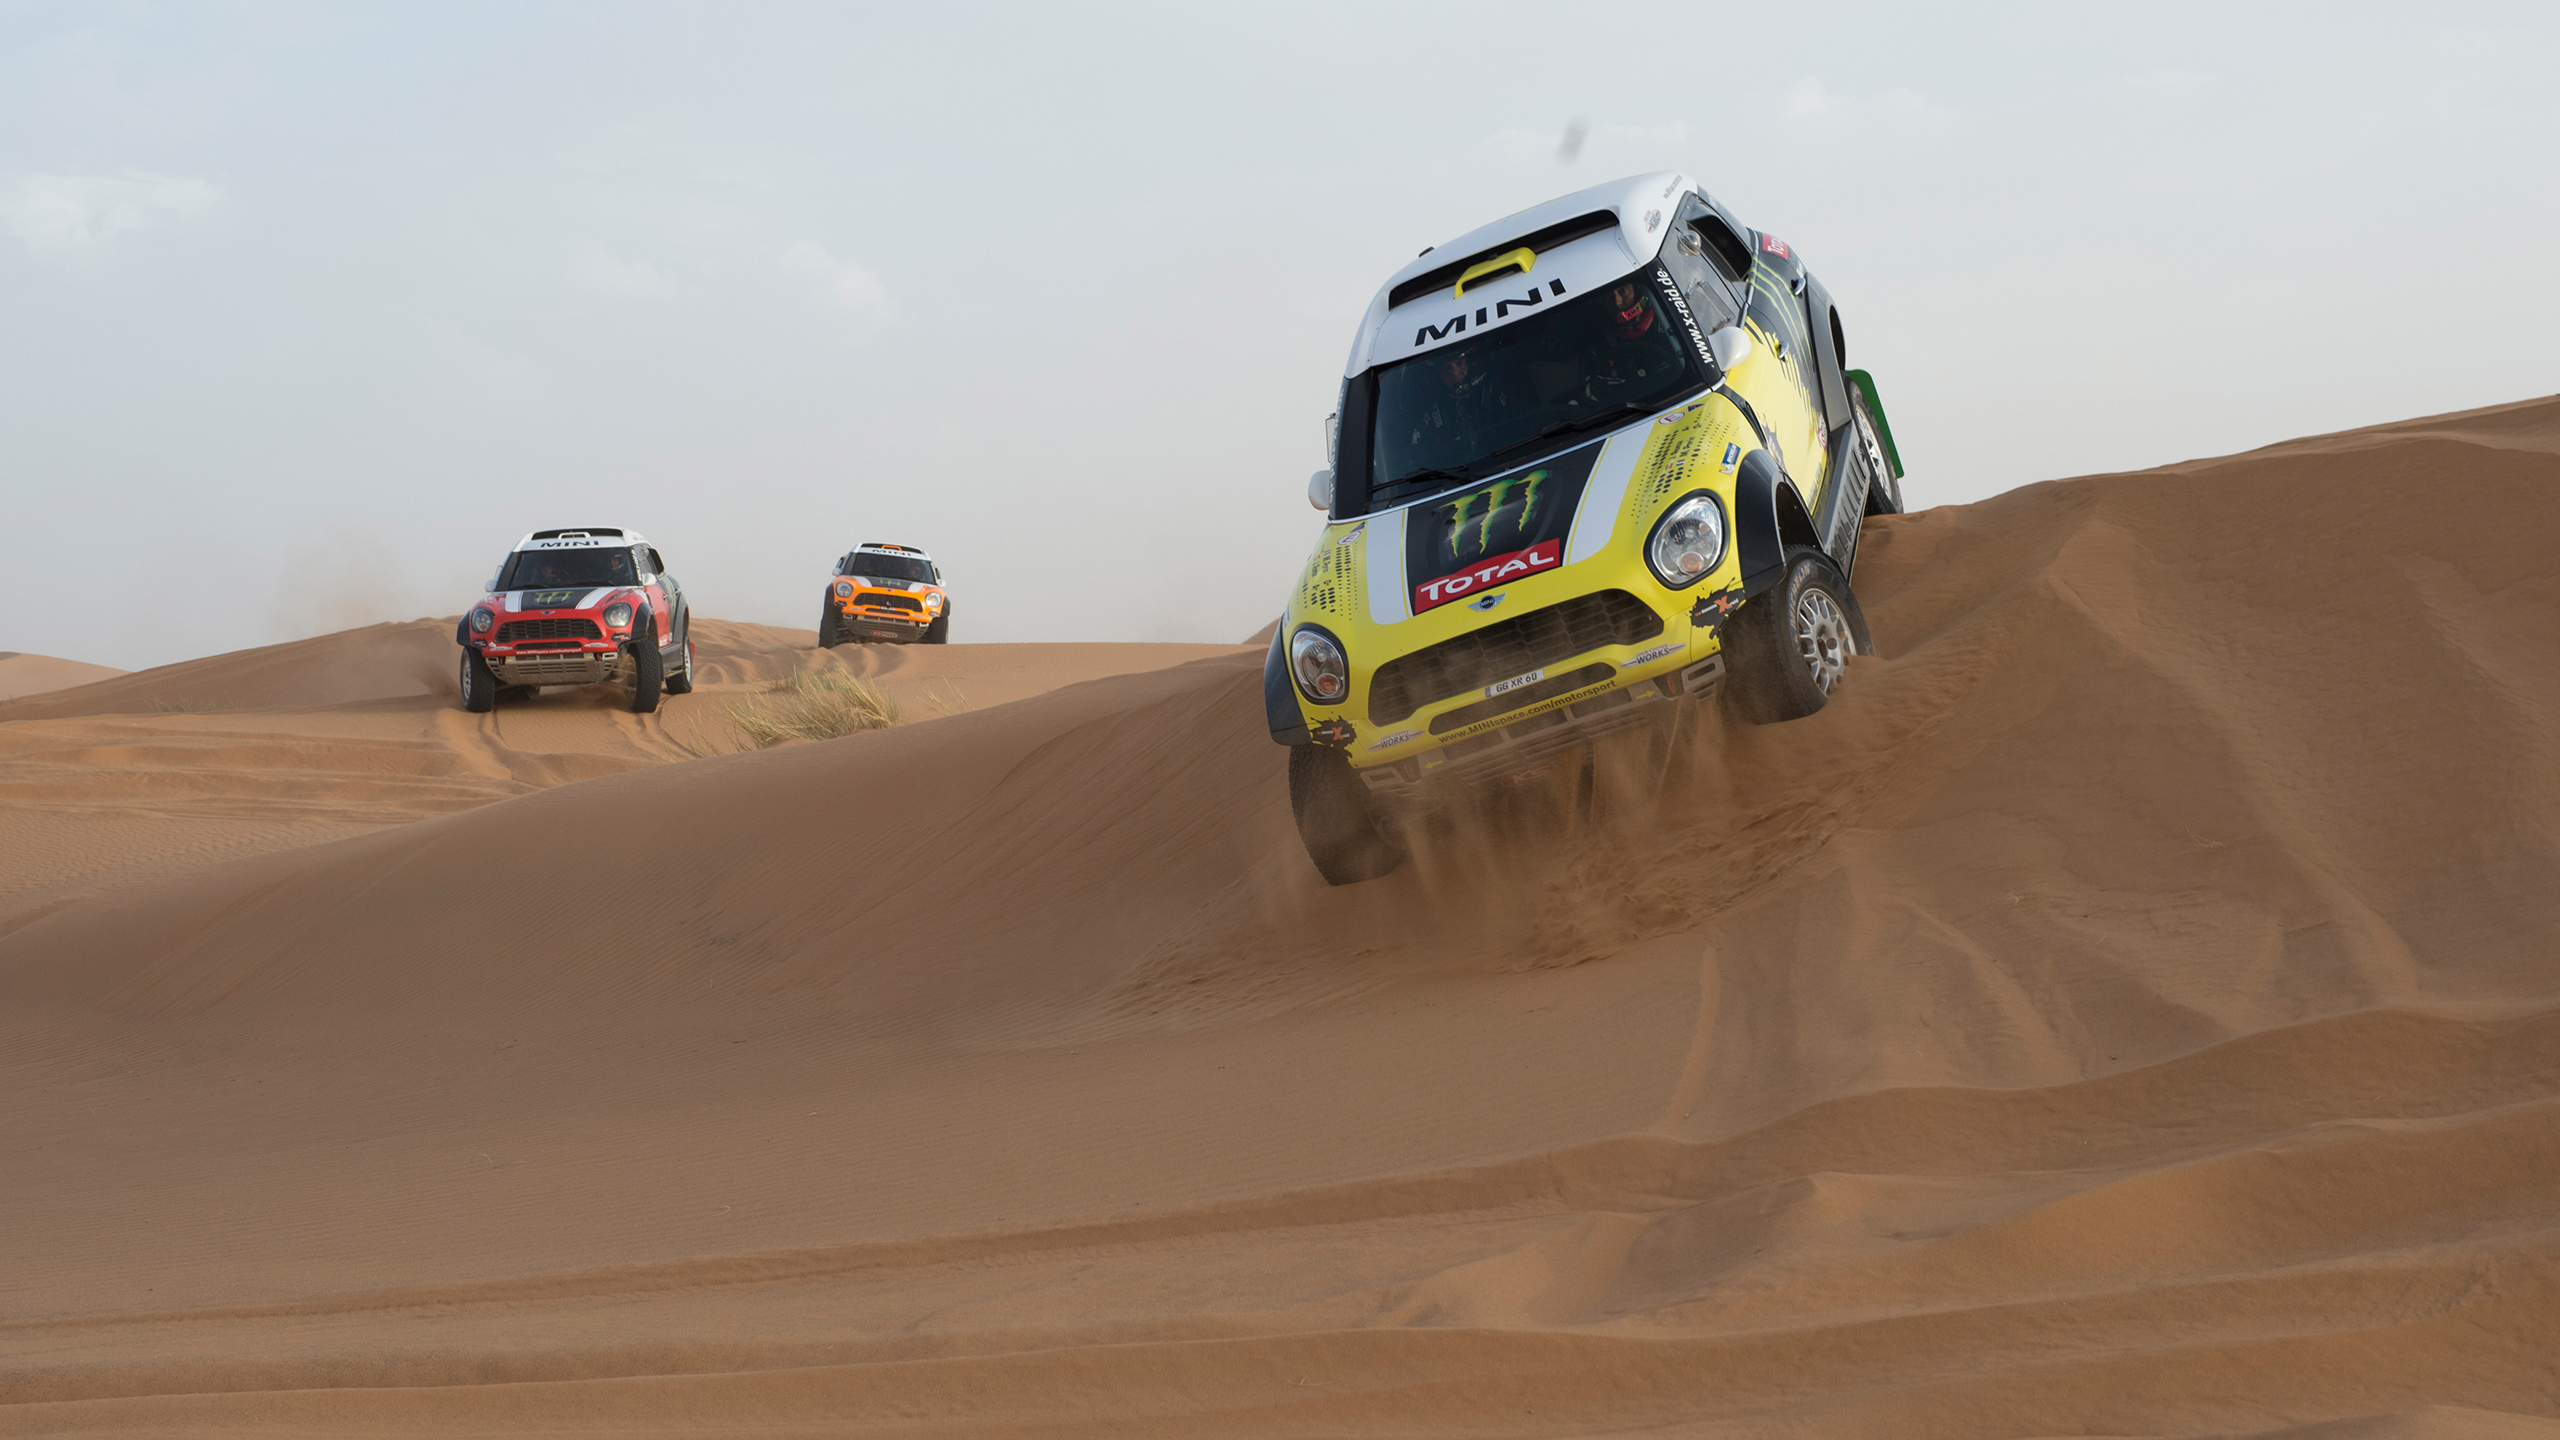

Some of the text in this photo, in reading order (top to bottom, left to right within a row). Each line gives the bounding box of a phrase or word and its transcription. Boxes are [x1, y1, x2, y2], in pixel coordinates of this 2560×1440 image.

[1414, 278, 1567, 346] MINI
[540, 540, 600, 548] MINI
[872, 548, 912, 556] MINI
[1420, 551, 1555, 601] TOTAL
[1789, 563, 1813, 629] MICHELIN
[1636, 647, 1670, 665] WORKS
[1496, 671, 1538, 693] GG XR 60
[1438, 679, 1617, 744] www.MINIspace.com/motorsport
[1379, 733, 1411, 749] WORKS
